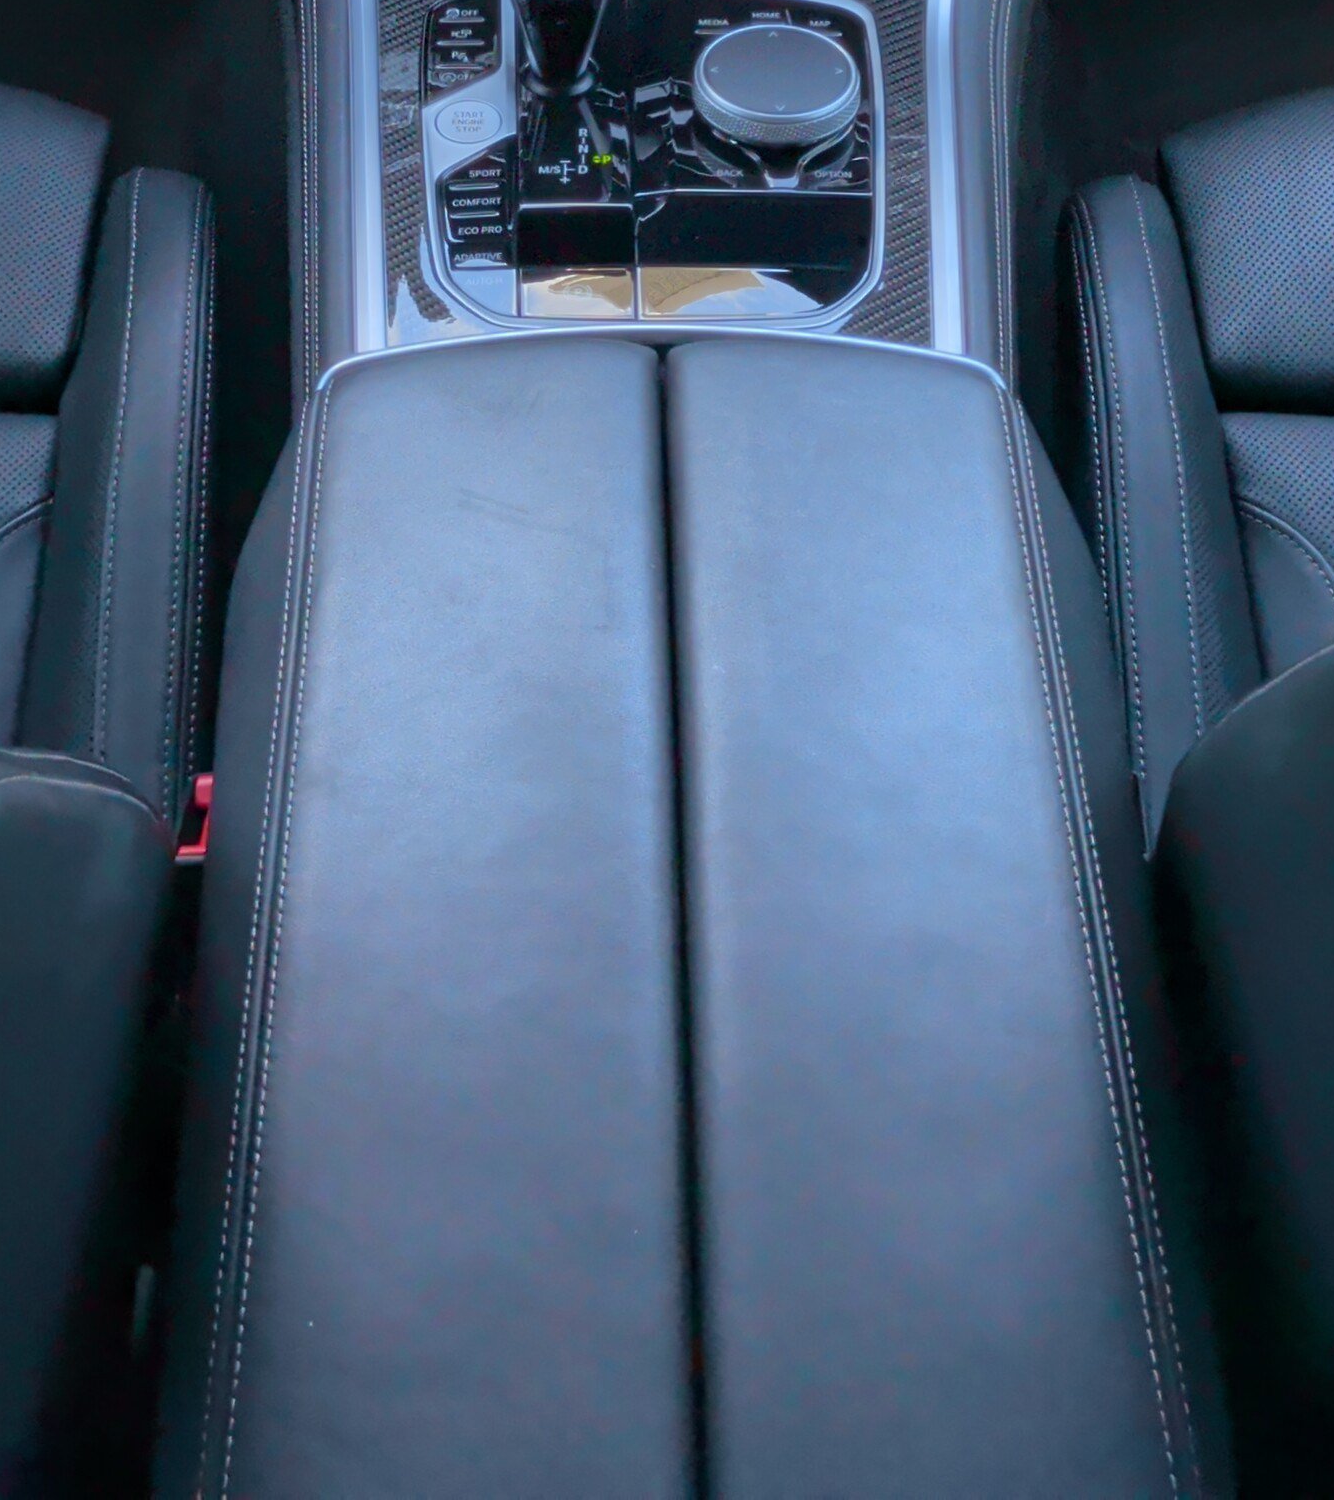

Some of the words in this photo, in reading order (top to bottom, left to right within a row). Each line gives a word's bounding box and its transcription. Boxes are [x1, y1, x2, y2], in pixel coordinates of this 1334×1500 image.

[453, 111, 485, 119] START
[578, 128, 588, 137] R
[578, 144, 588, 153] N
[603, 155, 612, 164] P
[469, 169, 502, 178] SPORT
[538, 165, 561, 175] M/S
[578, 165, 588, 174] D
[717, 169, 744, 177] BACK
[452, 197, 502, 207] COMFORT
[458, 226, 479, 235] ECO
[481, 225, 503, 234] PRO
[454, 252, 502, 261] ADAPTIVE
